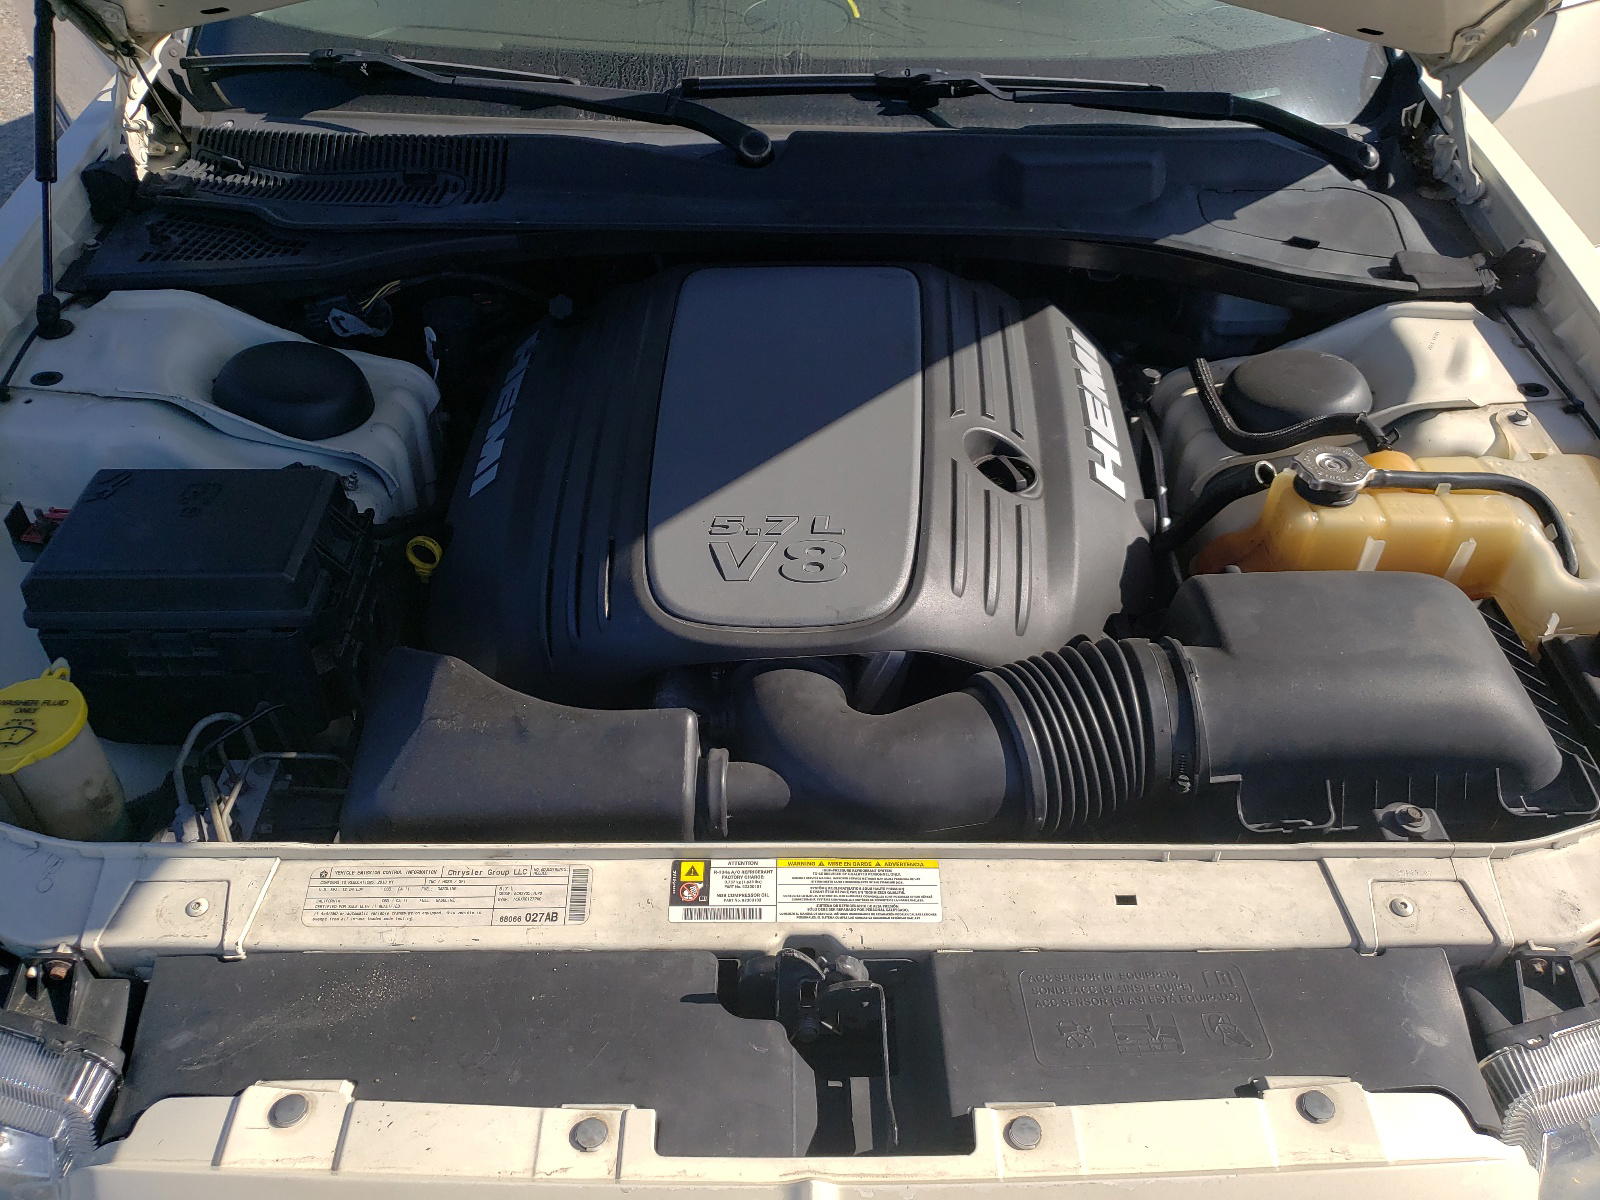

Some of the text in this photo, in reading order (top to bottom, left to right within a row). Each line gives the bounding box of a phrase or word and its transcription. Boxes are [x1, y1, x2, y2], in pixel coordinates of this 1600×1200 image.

[468, 329, 540, 498] HEMI
[1066, 327, 1126, 502] HEMI
[708, 515, 846, 536] 5.7 L
[708, 539, 848, 583] V8
[447, 869, 483, 877] Chrysler
[524, 911, 559, 922] 027AB
[1054, 972, 1101, 982] SENSOR
[1062, 997, 1108, 1007] SENSOR
